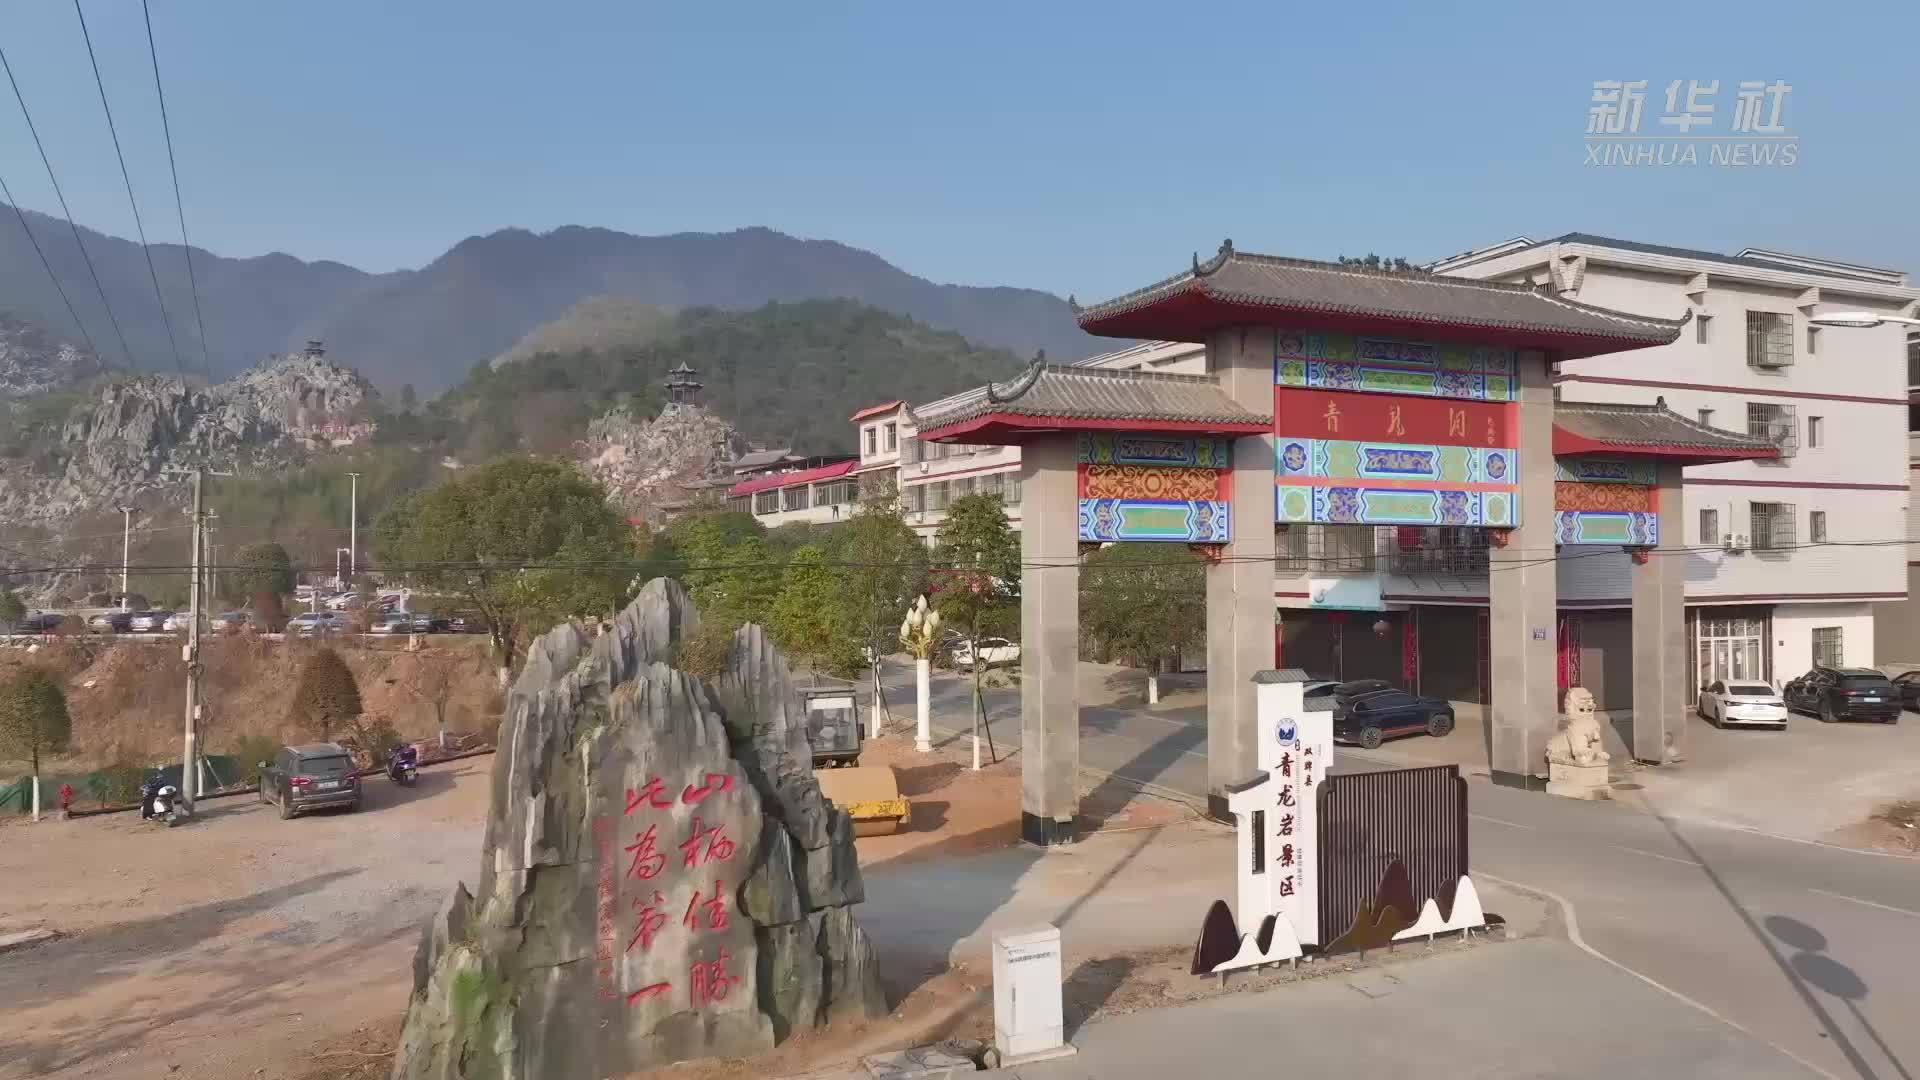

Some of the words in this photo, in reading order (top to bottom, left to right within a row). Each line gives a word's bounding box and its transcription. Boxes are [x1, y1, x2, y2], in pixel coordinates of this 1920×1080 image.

[1275, 751, 1296, 897] 青龙岩景区
